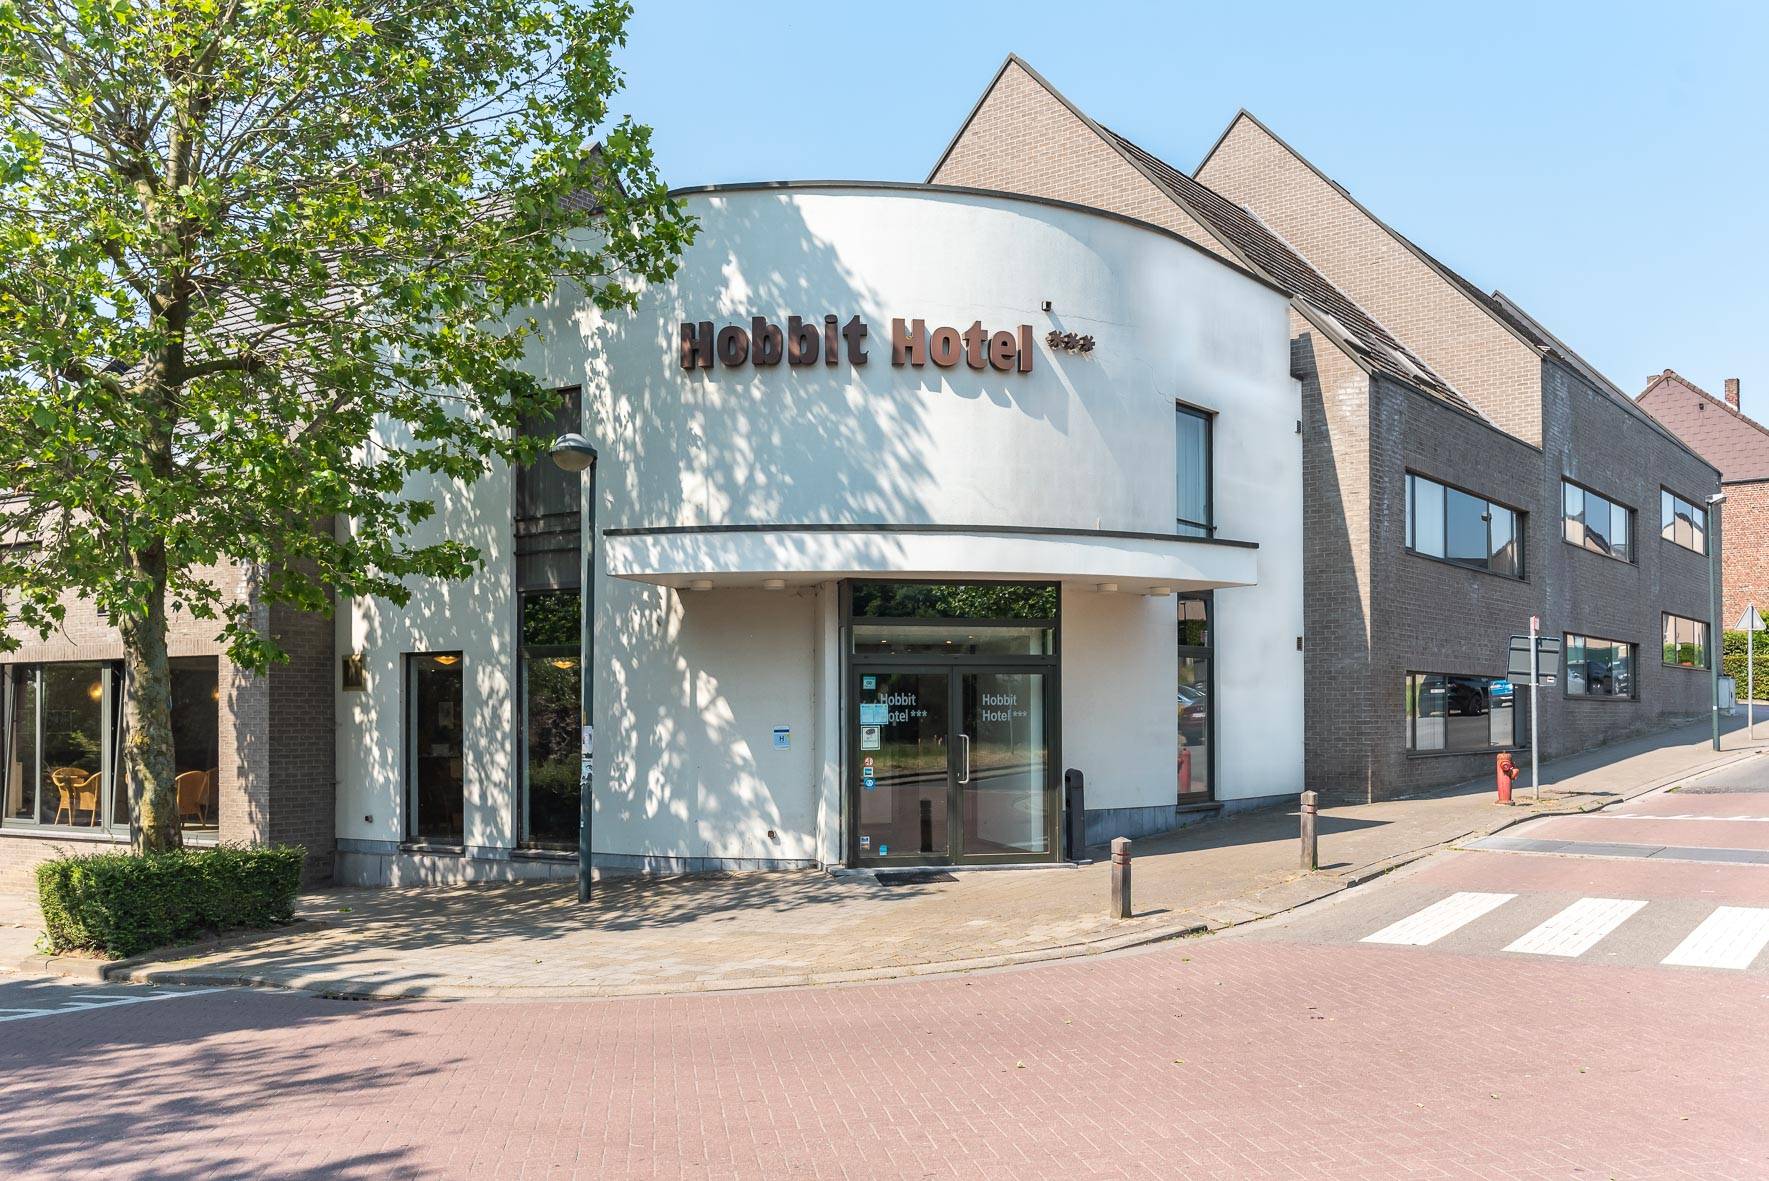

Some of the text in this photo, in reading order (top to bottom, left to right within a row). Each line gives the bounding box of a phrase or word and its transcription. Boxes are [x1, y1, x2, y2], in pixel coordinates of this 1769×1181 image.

[680, 314, 1033, 373] Hobbit Hotel
[880, 693, 916, 706] Hobbit
[982, 693, 1017, 706] Hobbit
[887, 709, 909, 722] otel
